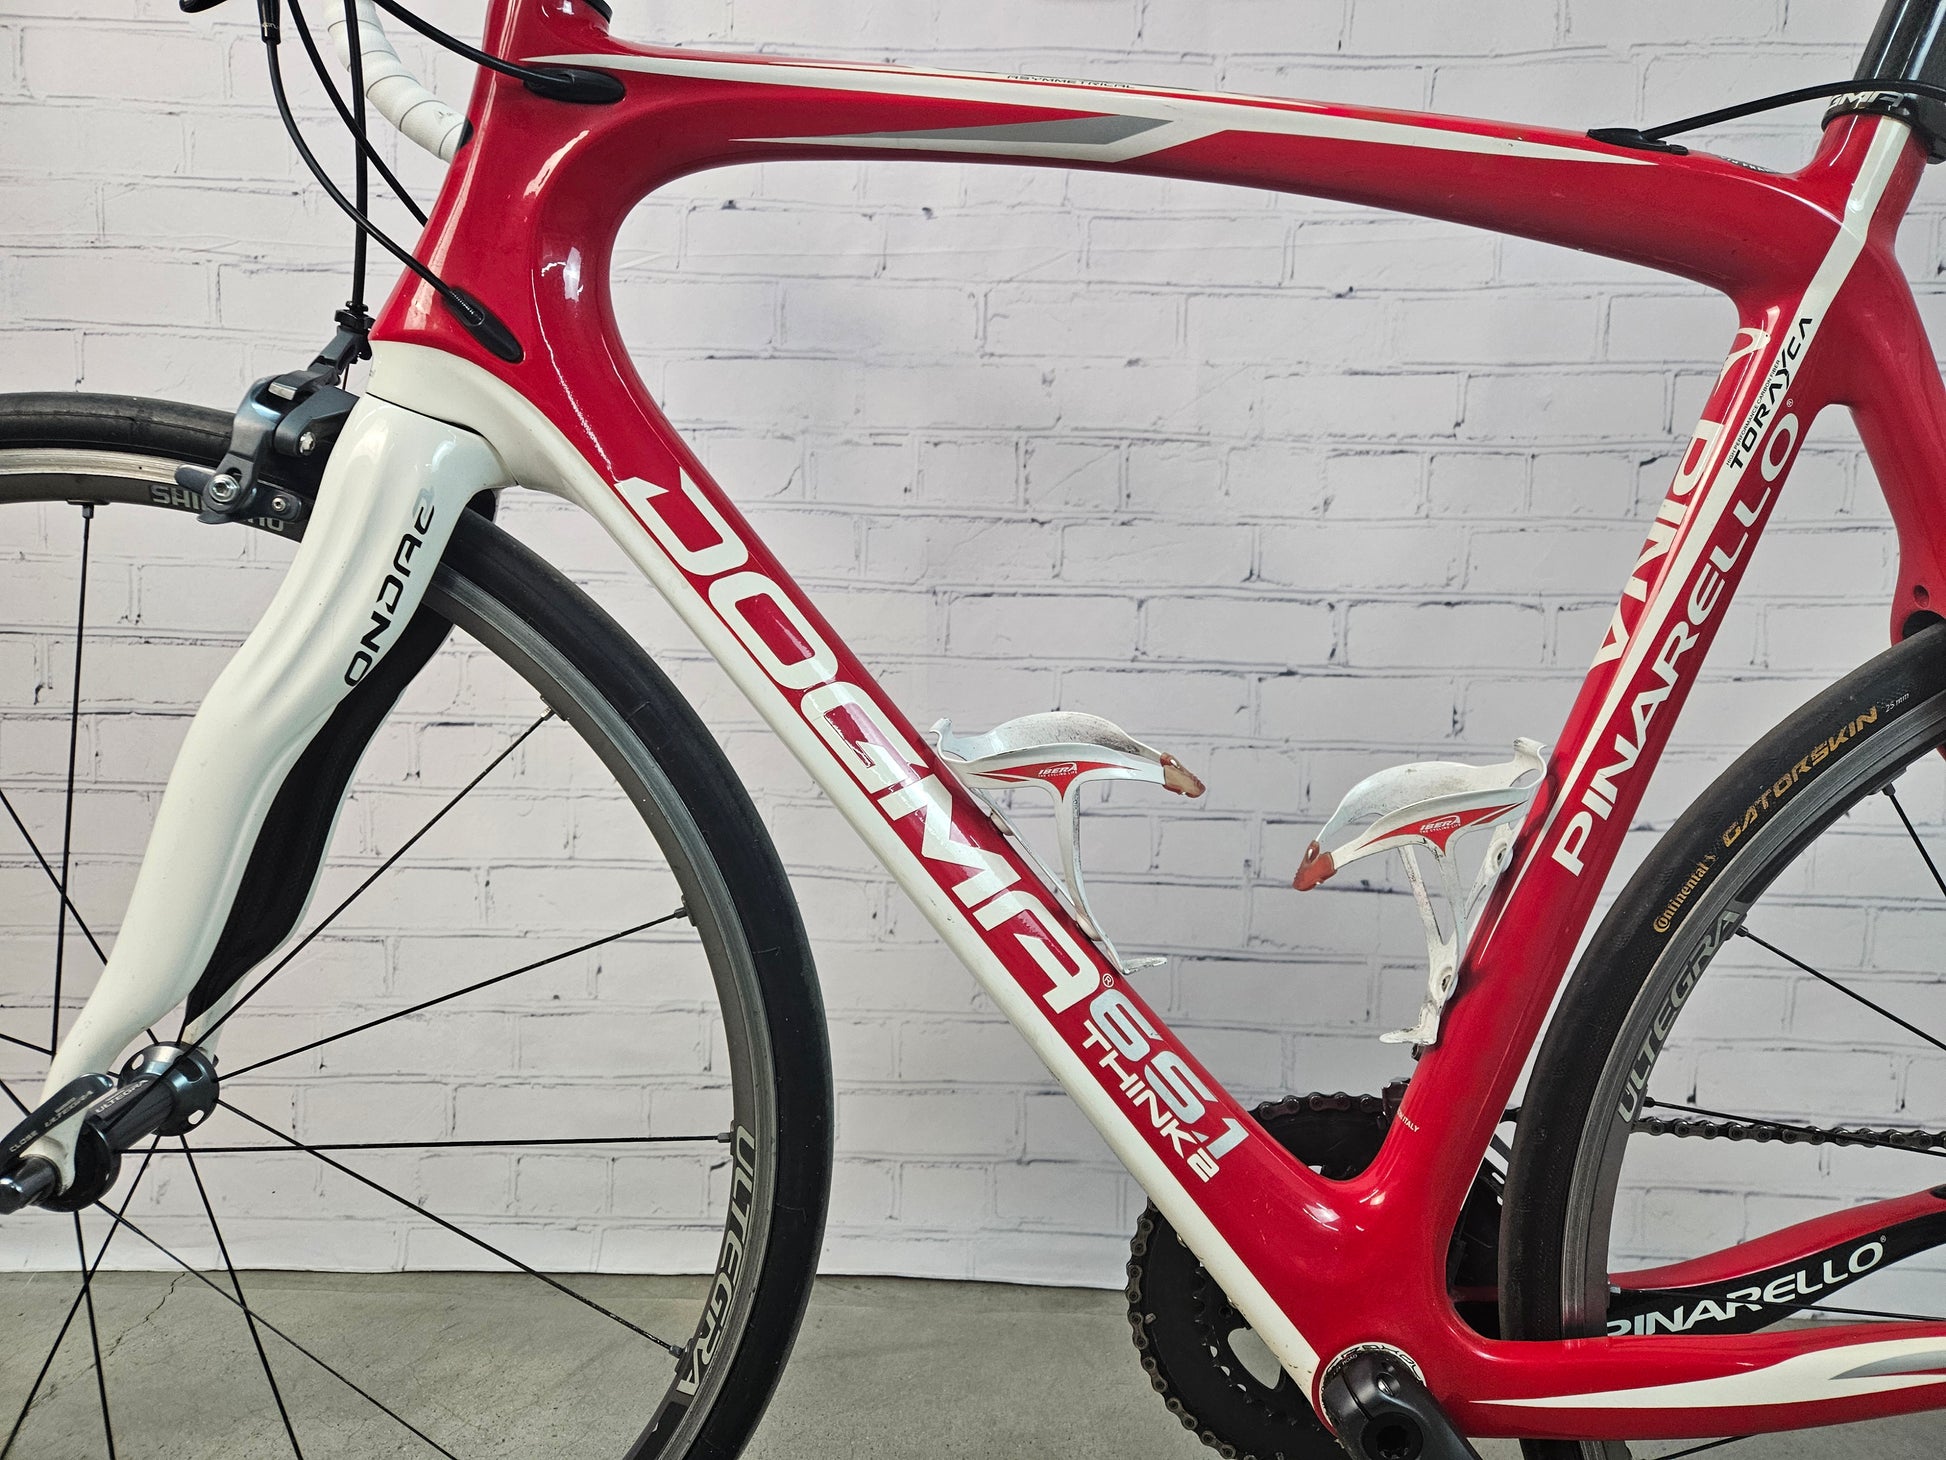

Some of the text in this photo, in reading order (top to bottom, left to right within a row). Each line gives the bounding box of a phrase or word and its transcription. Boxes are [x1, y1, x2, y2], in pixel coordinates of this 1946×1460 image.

[1729, 317, 1813, 470] TORAYCA
[1038, 762, 1077, 775] IBERA
[1721, 705, 1878, 847] GATORSKIN
[1420, 815, 1461, 831] IBERA
[1653, 861, 1710, 933] Continental
[1618, 910, 1740, 1123] ULTEGRA
[9, 1130, 38, 1153] CLOSE
[675, 1125, 755, 1396] ULTEGRA
